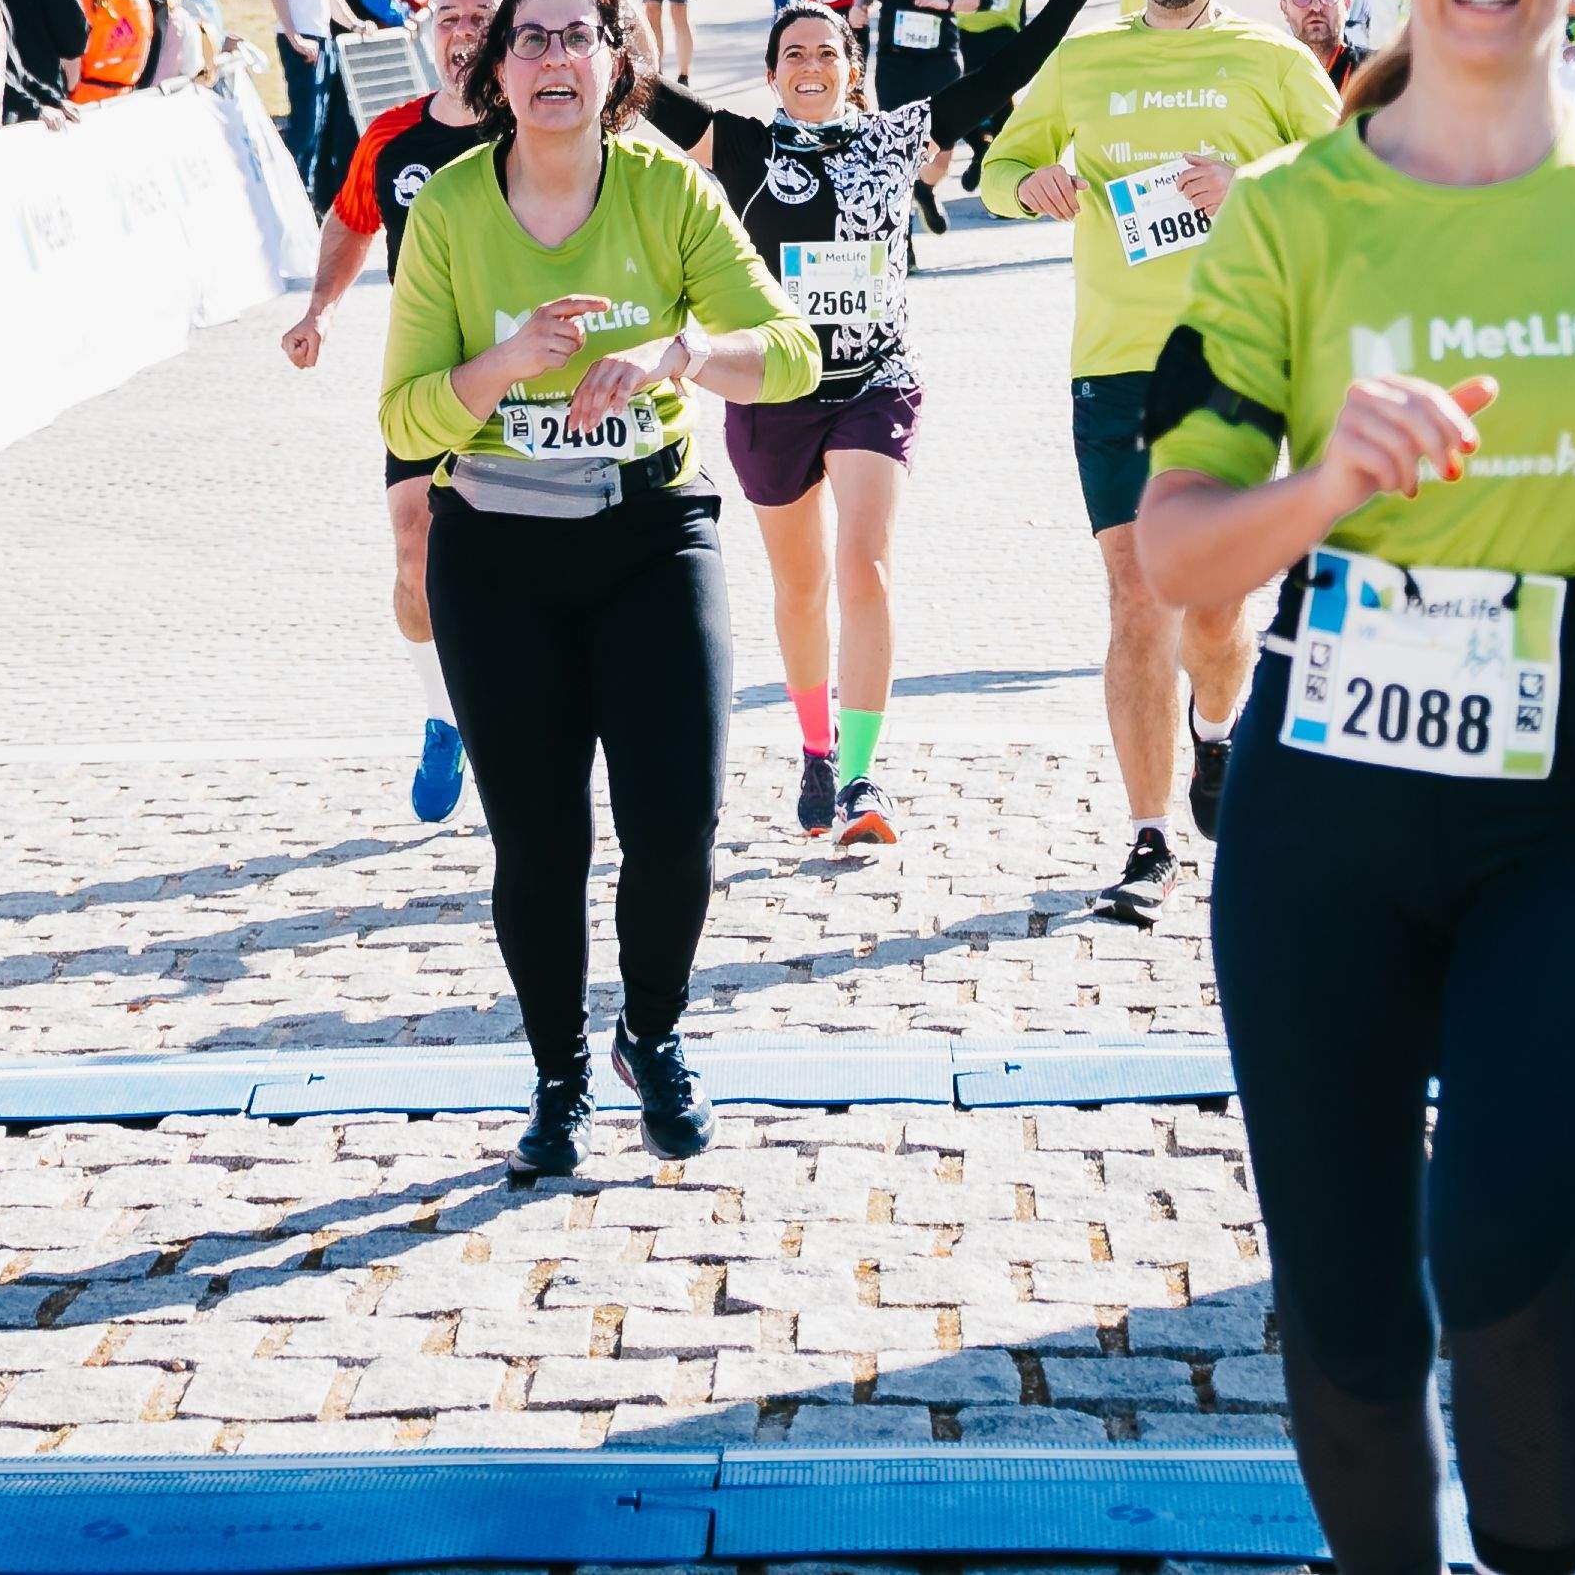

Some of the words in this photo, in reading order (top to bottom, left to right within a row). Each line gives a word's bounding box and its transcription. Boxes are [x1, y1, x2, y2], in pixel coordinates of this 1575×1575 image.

[1143, 88, 1228, 109] MetLife
[1100, 141, 1132, 164] VIII
[1148, 206, 1212, 247] 1988
[825, 252, 867, 262] MetLife
[807, 290, 868, 316] 2564
[1404, 594, 1503, 619] MetLife
[1342, 676, 1492, 755] 2088
